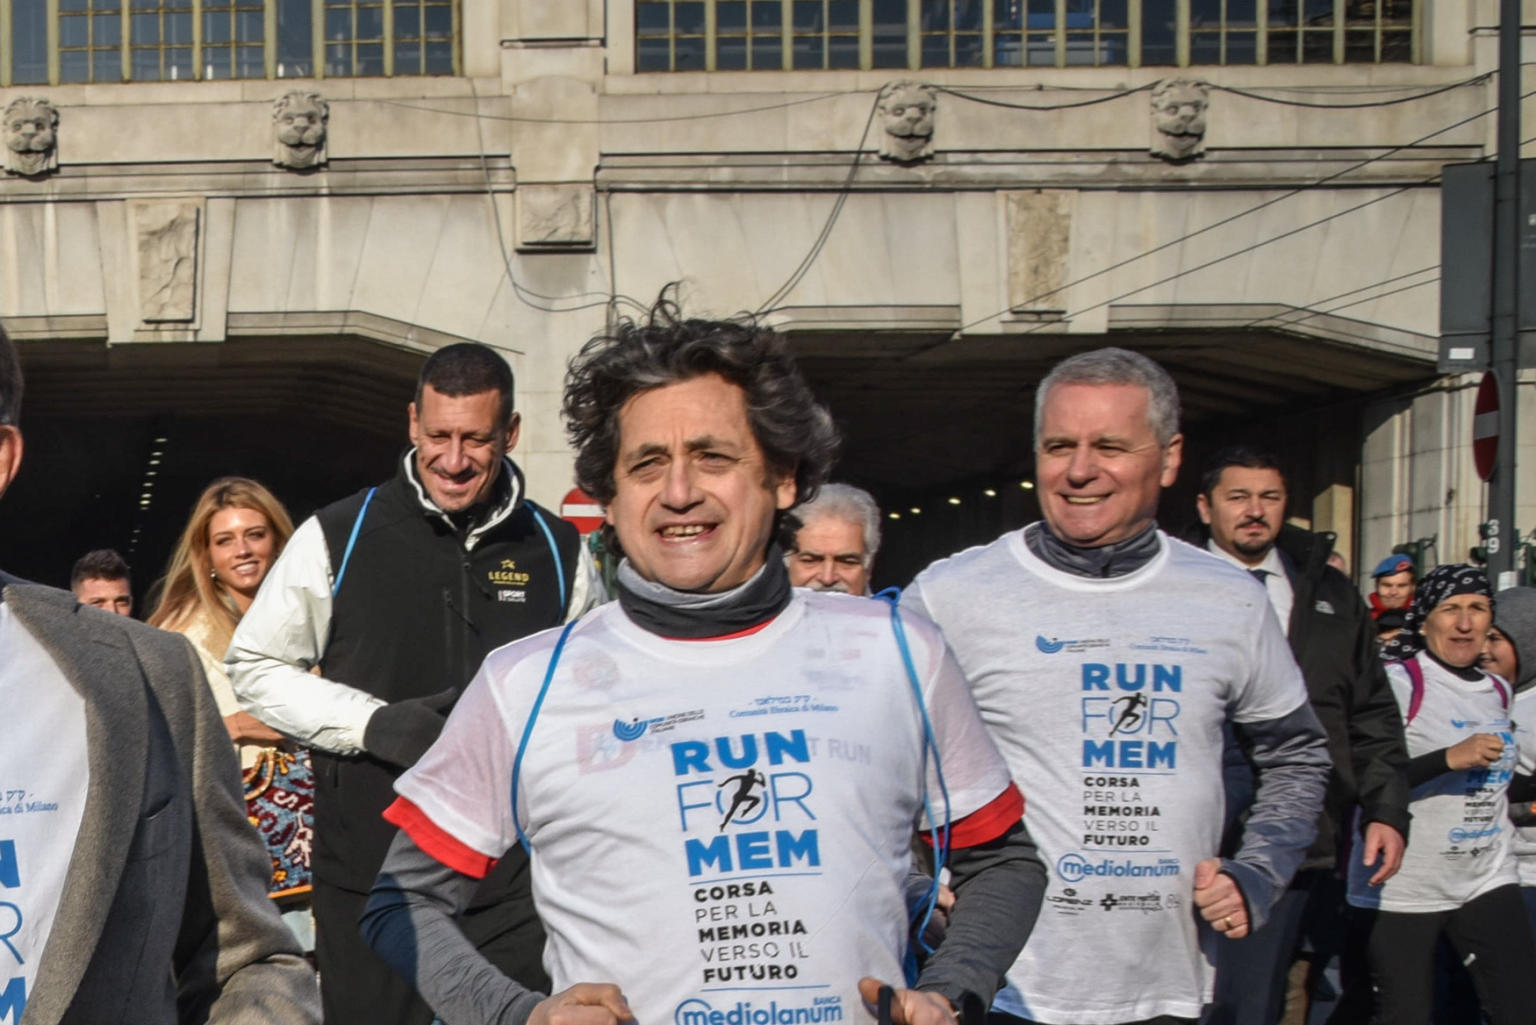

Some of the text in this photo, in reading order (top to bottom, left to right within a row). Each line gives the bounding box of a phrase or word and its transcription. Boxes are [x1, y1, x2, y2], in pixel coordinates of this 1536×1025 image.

[488, 571, 530, 582] LEGEND
[1081, 663, 1181, 692] RUN
[1081, 697, 1180, 736] FOR
[670, 729, 811, 776] RUN
[1082, 740, 1177, 769] MEM
[1084, 777, 1139, 788] CORSA
[677, 772, 818, 832] FOR
[1084, 791, 1142, 802] PER LA
[1084, 805, 1160, 817] MEMORIA
[1084, 820, 1159, 831] VERSO IL
[1084, 835, 1149, 846] FUTURO
[684, 829, 822, 877] MEM
[1062, 860, 1180, 877] mediolanum
[694, 881, 774, 902] CORSA
[695, 901, 778, 923] PER LA
[698, 919, 808, 943] MEMORIA
[700, 942, 809, 963] VERSO IL
[703, 964, 798, 983] FUTURO
